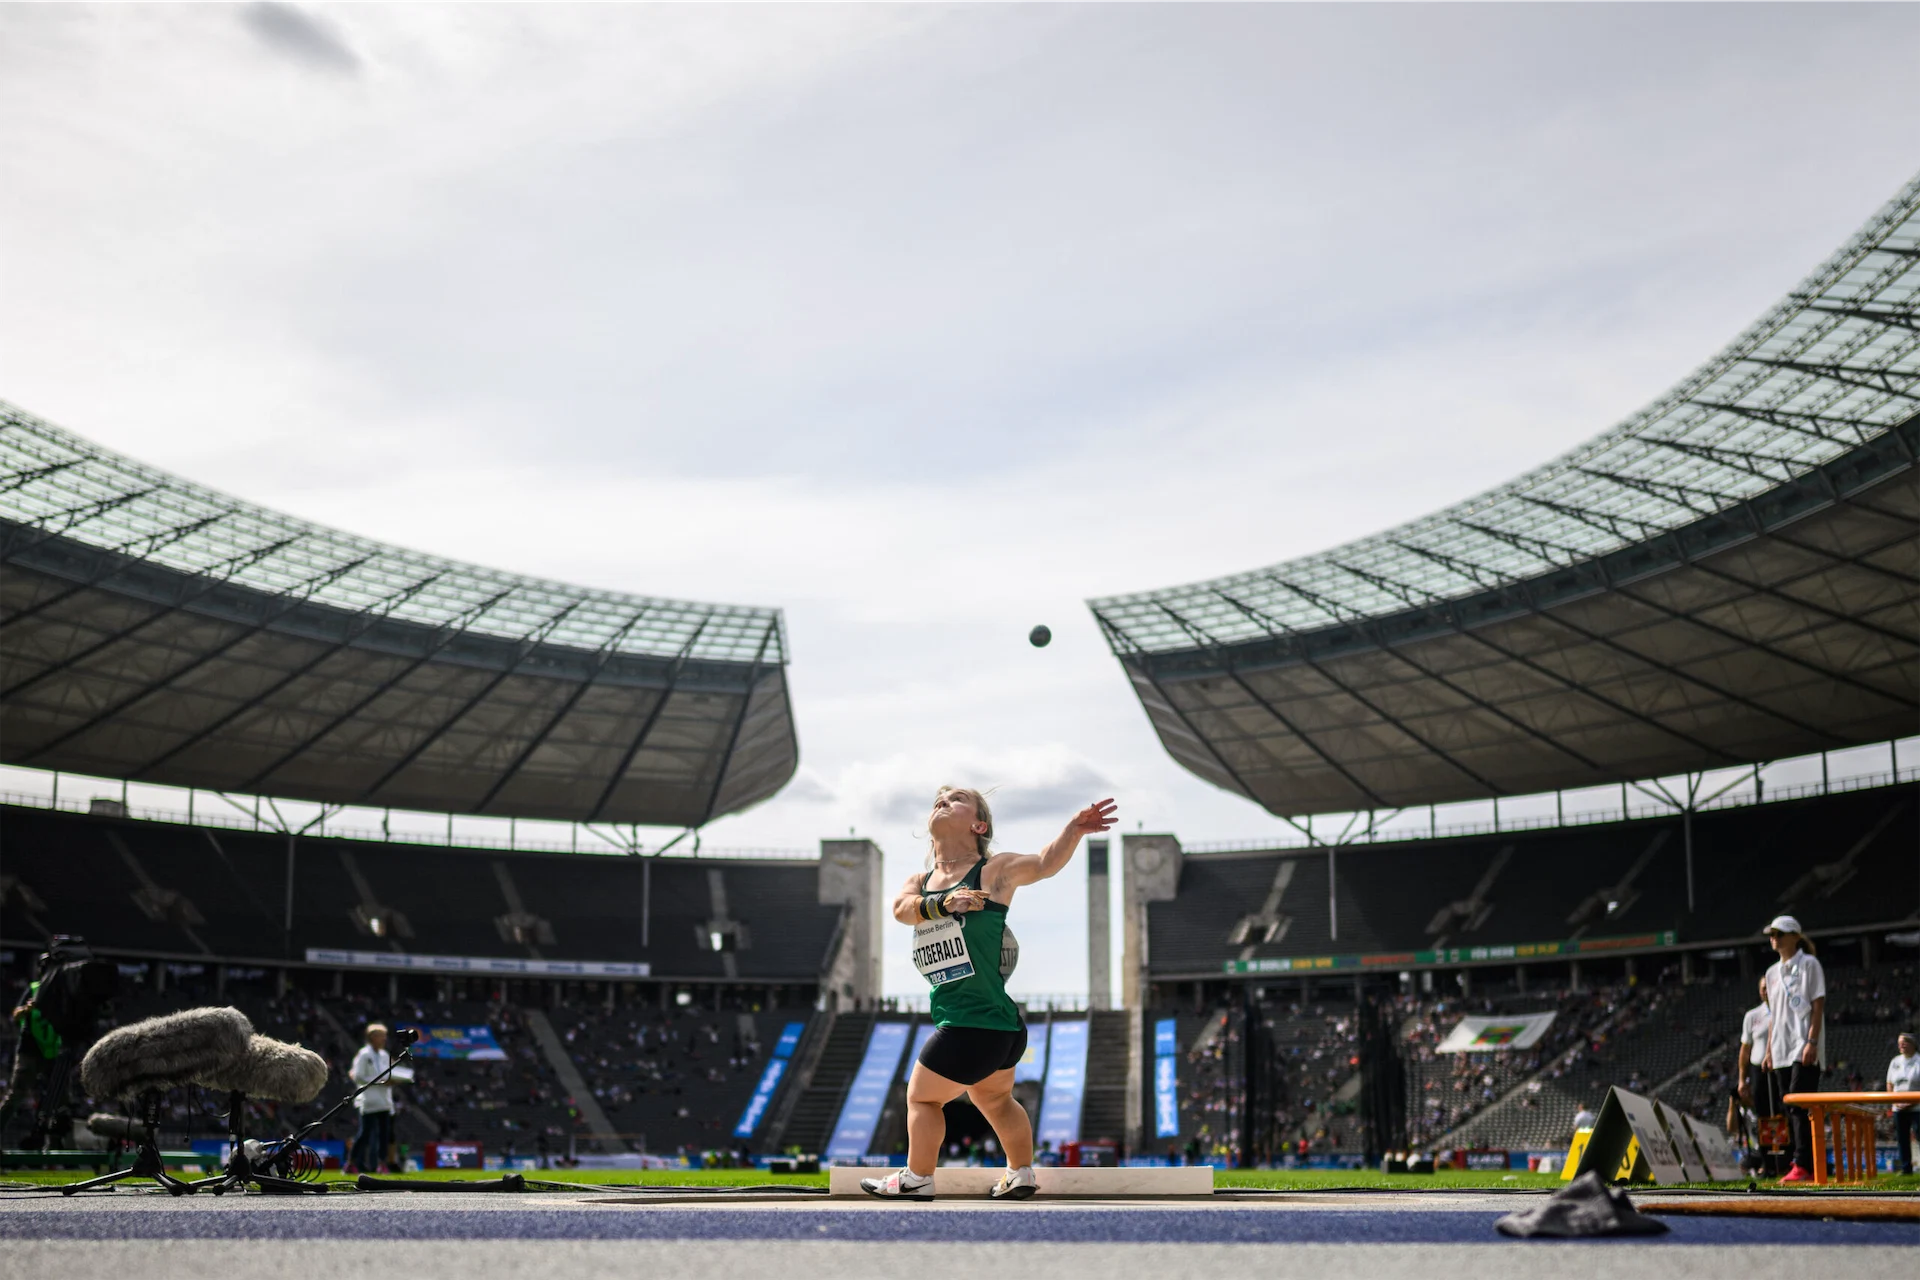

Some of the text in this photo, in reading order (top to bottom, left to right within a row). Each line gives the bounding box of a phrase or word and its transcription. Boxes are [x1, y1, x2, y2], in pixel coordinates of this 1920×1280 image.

[917, 920, 954, 937] Messe Berlin
[913, 936, 965, 969] FITZGERALD
[930, 970, 947, 984] 2023
